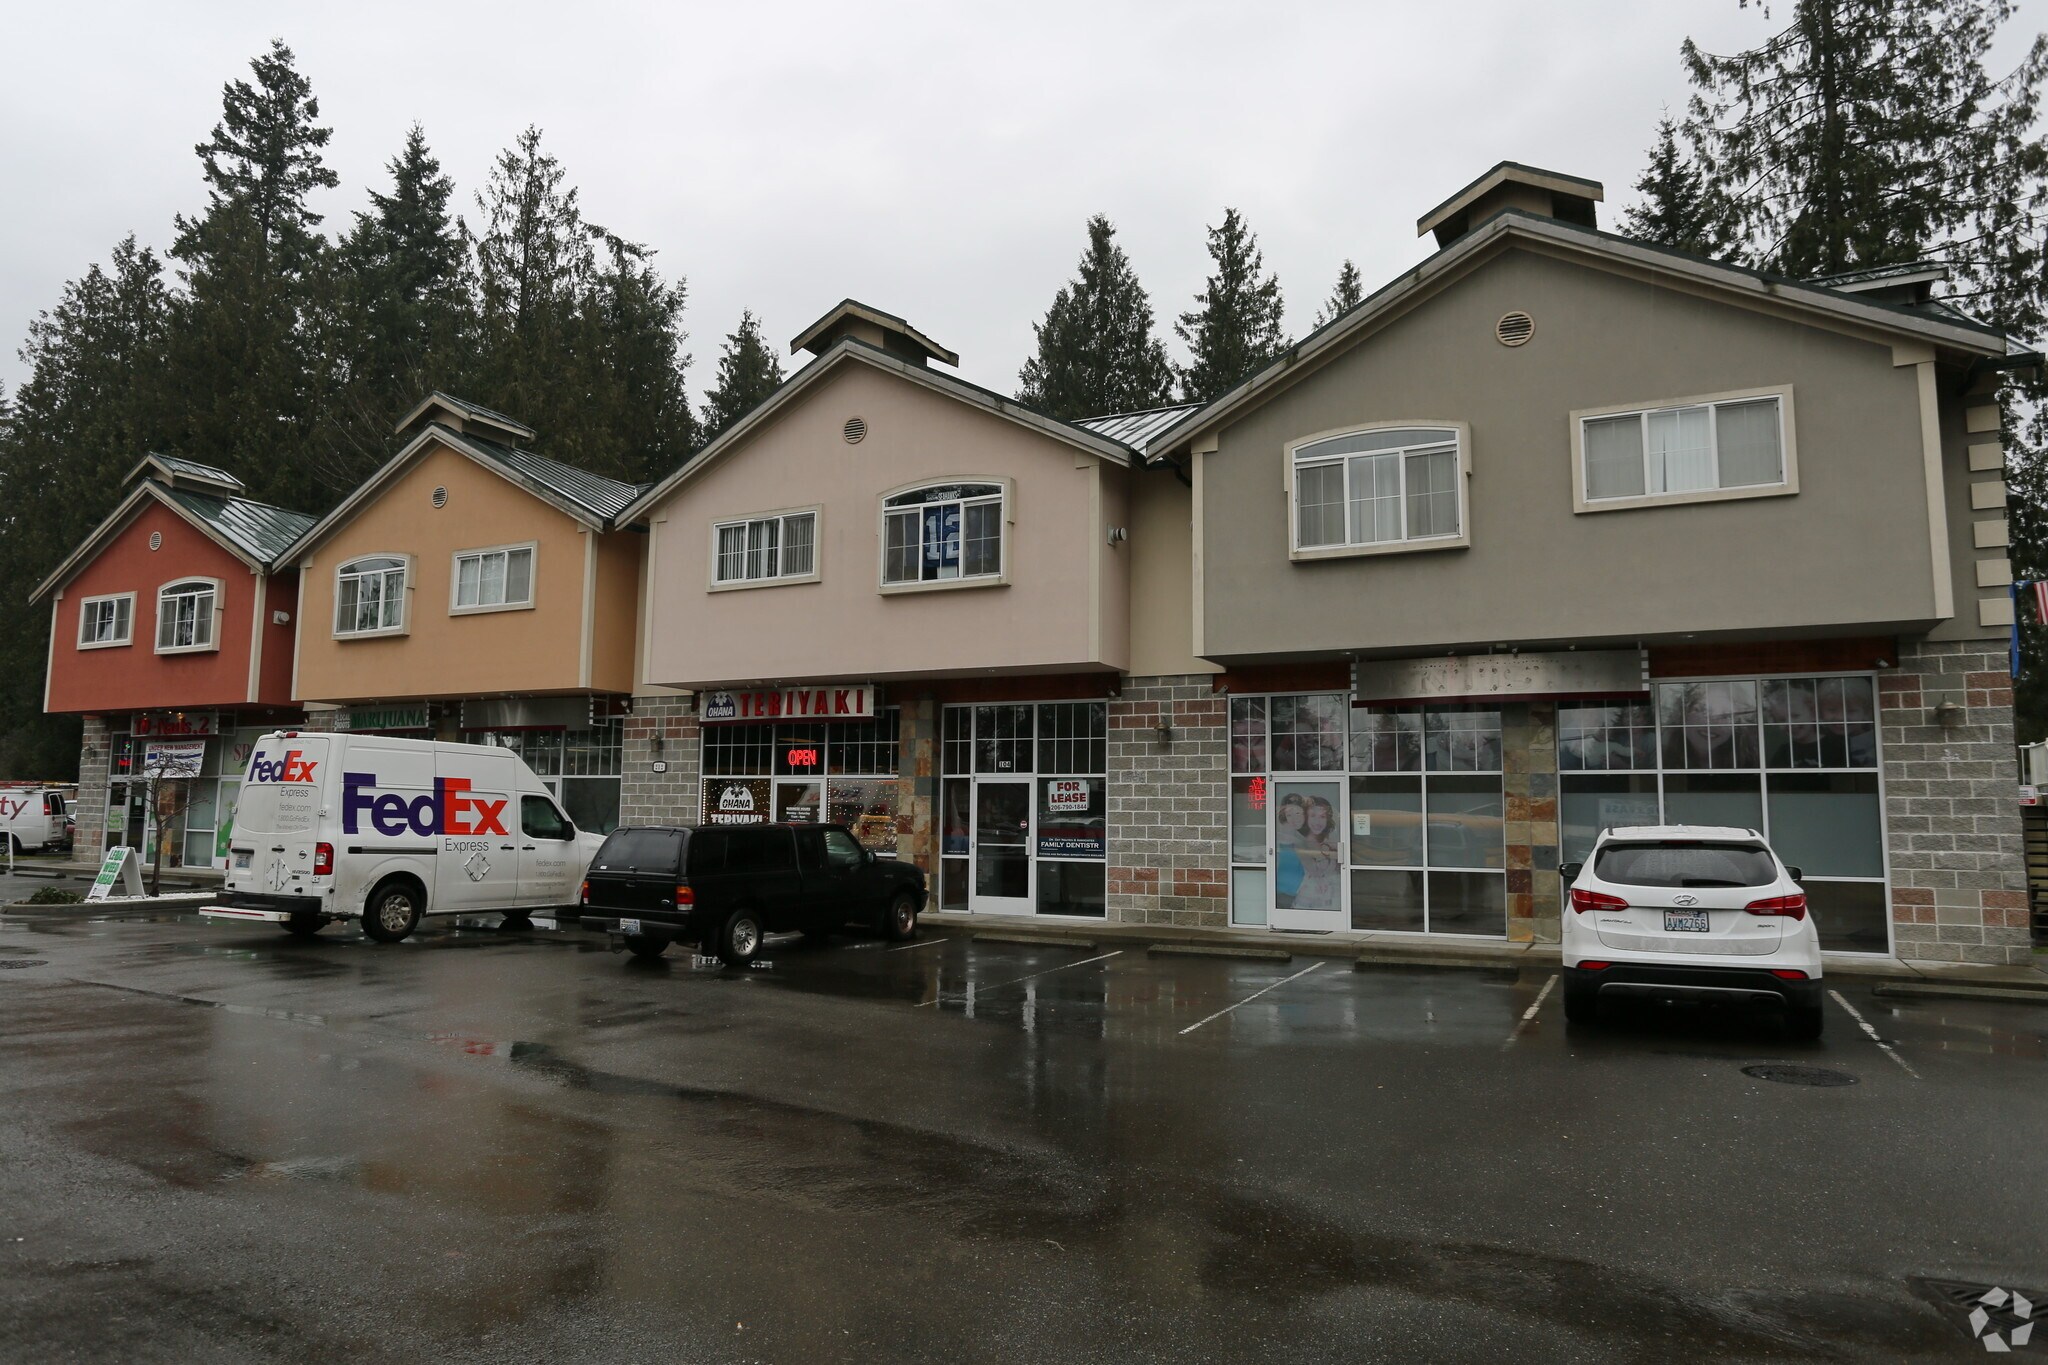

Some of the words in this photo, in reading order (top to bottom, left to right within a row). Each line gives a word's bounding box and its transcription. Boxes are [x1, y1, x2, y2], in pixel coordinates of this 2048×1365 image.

[925, 513, 960, 560] 12
[740, 689, 864, 717] TERIYAKI
[708, 706, 733, 717] OHANA
[352, 710, 425, 729] MARIJUANA
[233, 743, 250, 761] SP
[788, 750, 816, 766] OPEN
[248, 750, 318, 783] FedEx
[280, 786, 309, 798] Express
[1057, 782, 1080, 791] FOR
[343, 772, 509, 837] FedEx
[722, 799, 751, 809] OHANA
[1051, 793, 1086, 803] LEASE
[279, 802, 311, 812] fedex.com
[445, 838, 489, 854] Express
[108, 849, 126, 861] LEGAL
[1667, 917, 1706, 929] AVM2766
